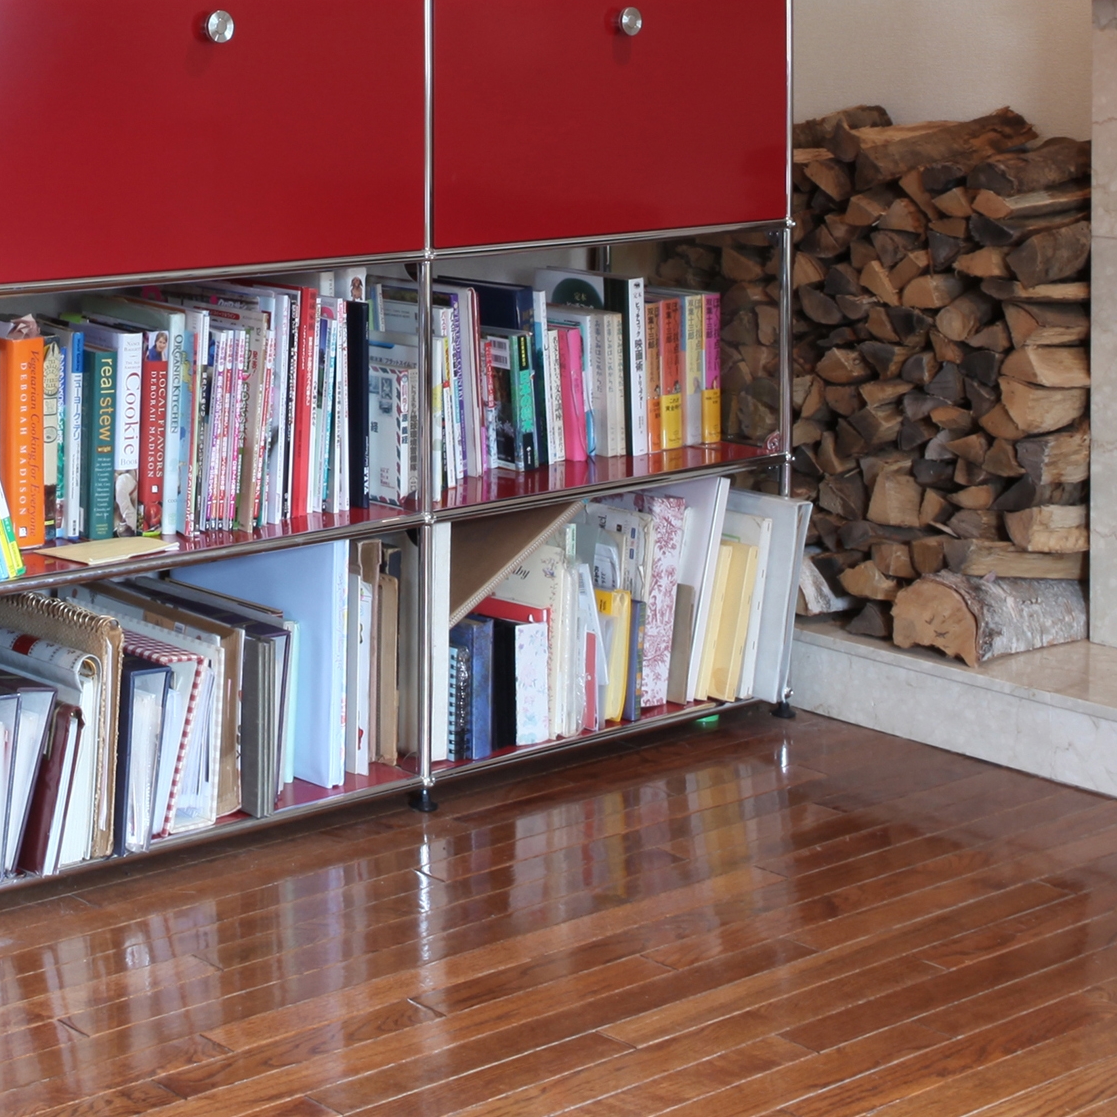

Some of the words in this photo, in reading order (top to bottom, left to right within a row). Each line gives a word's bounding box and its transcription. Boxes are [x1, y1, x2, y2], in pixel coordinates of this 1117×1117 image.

[30, 350, 40, 409] Vegetarian
[100, 358, 115, 393] real
[171, 334, 184, 384] ORGANIC
[20, 362, 28, 435] DEBORAH
[73, 375, 82, 441] ニューヨーク・デリ
[99, 397, 114, 441] stew
[124, 372, 141, 455] Cookie
[149, 371, 157, 421] DEBORAH
[158, 371, 166, 415] LOCAL
[170, 385, 181, 434] KITCHEN
[29, 413, 40, 460] Cooking
[147, 426, 156, 478] MADISON
[156, 420, 164, 478] FLAVORS
[19, 444, 28, 516] MADISON
[29, 484, 40, 537] Everyone
